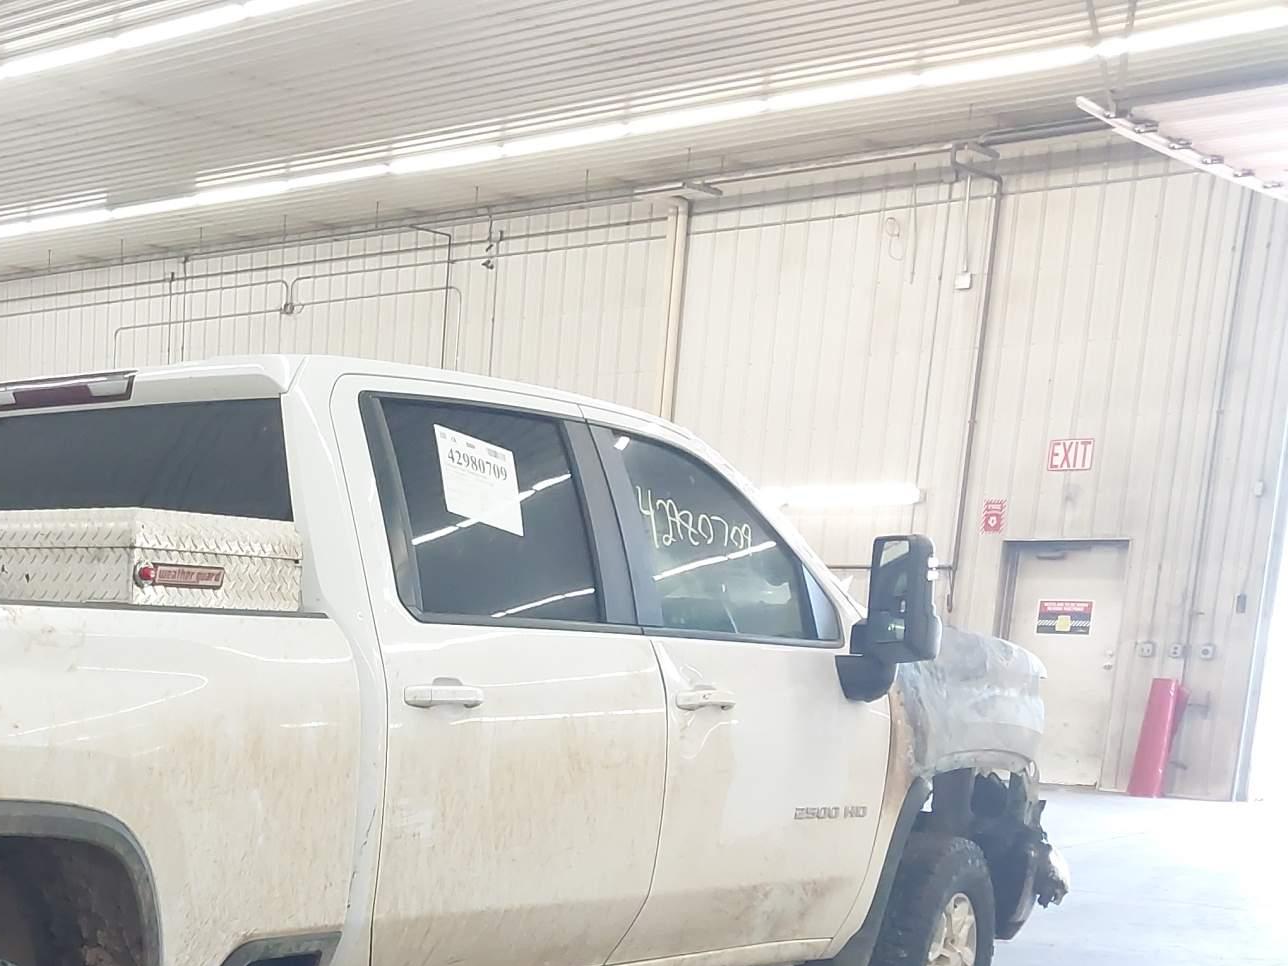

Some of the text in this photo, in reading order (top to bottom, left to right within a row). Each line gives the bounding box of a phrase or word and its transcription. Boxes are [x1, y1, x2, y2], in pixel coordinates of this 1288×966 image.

[447, 447, 508, 481] 42980709
[1050, 440, 1092, 469] EXIT
[794, 806, 867, 820] 2500 HD
